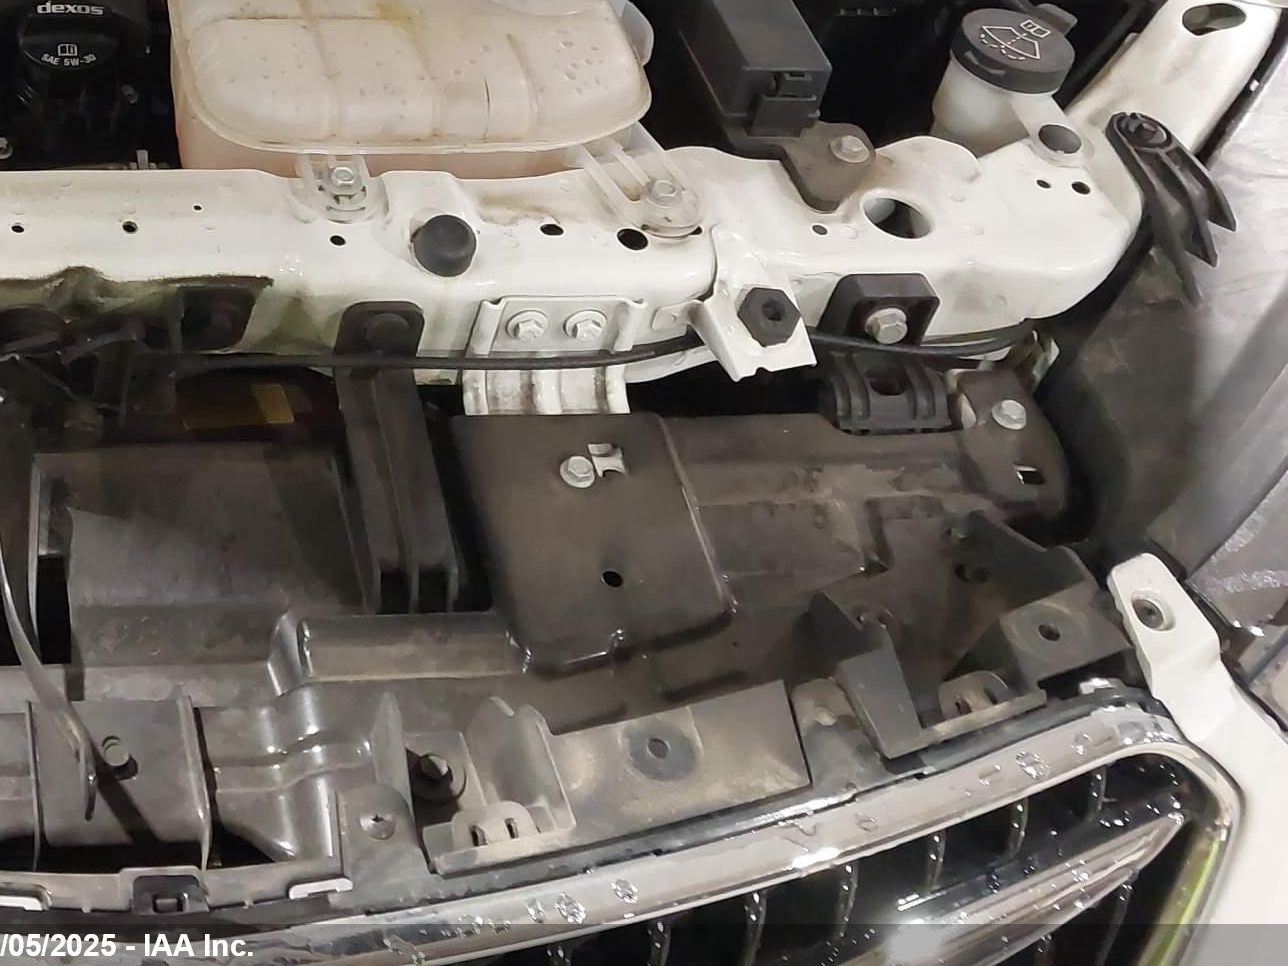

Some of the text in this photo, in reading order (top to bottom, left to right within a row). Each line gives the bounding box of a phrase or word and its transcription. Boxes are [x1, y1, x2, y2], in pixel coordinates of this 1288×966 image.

[36, 0, 104, 15] dexos
[41, 53, 97, 67] SAE 5W-30
